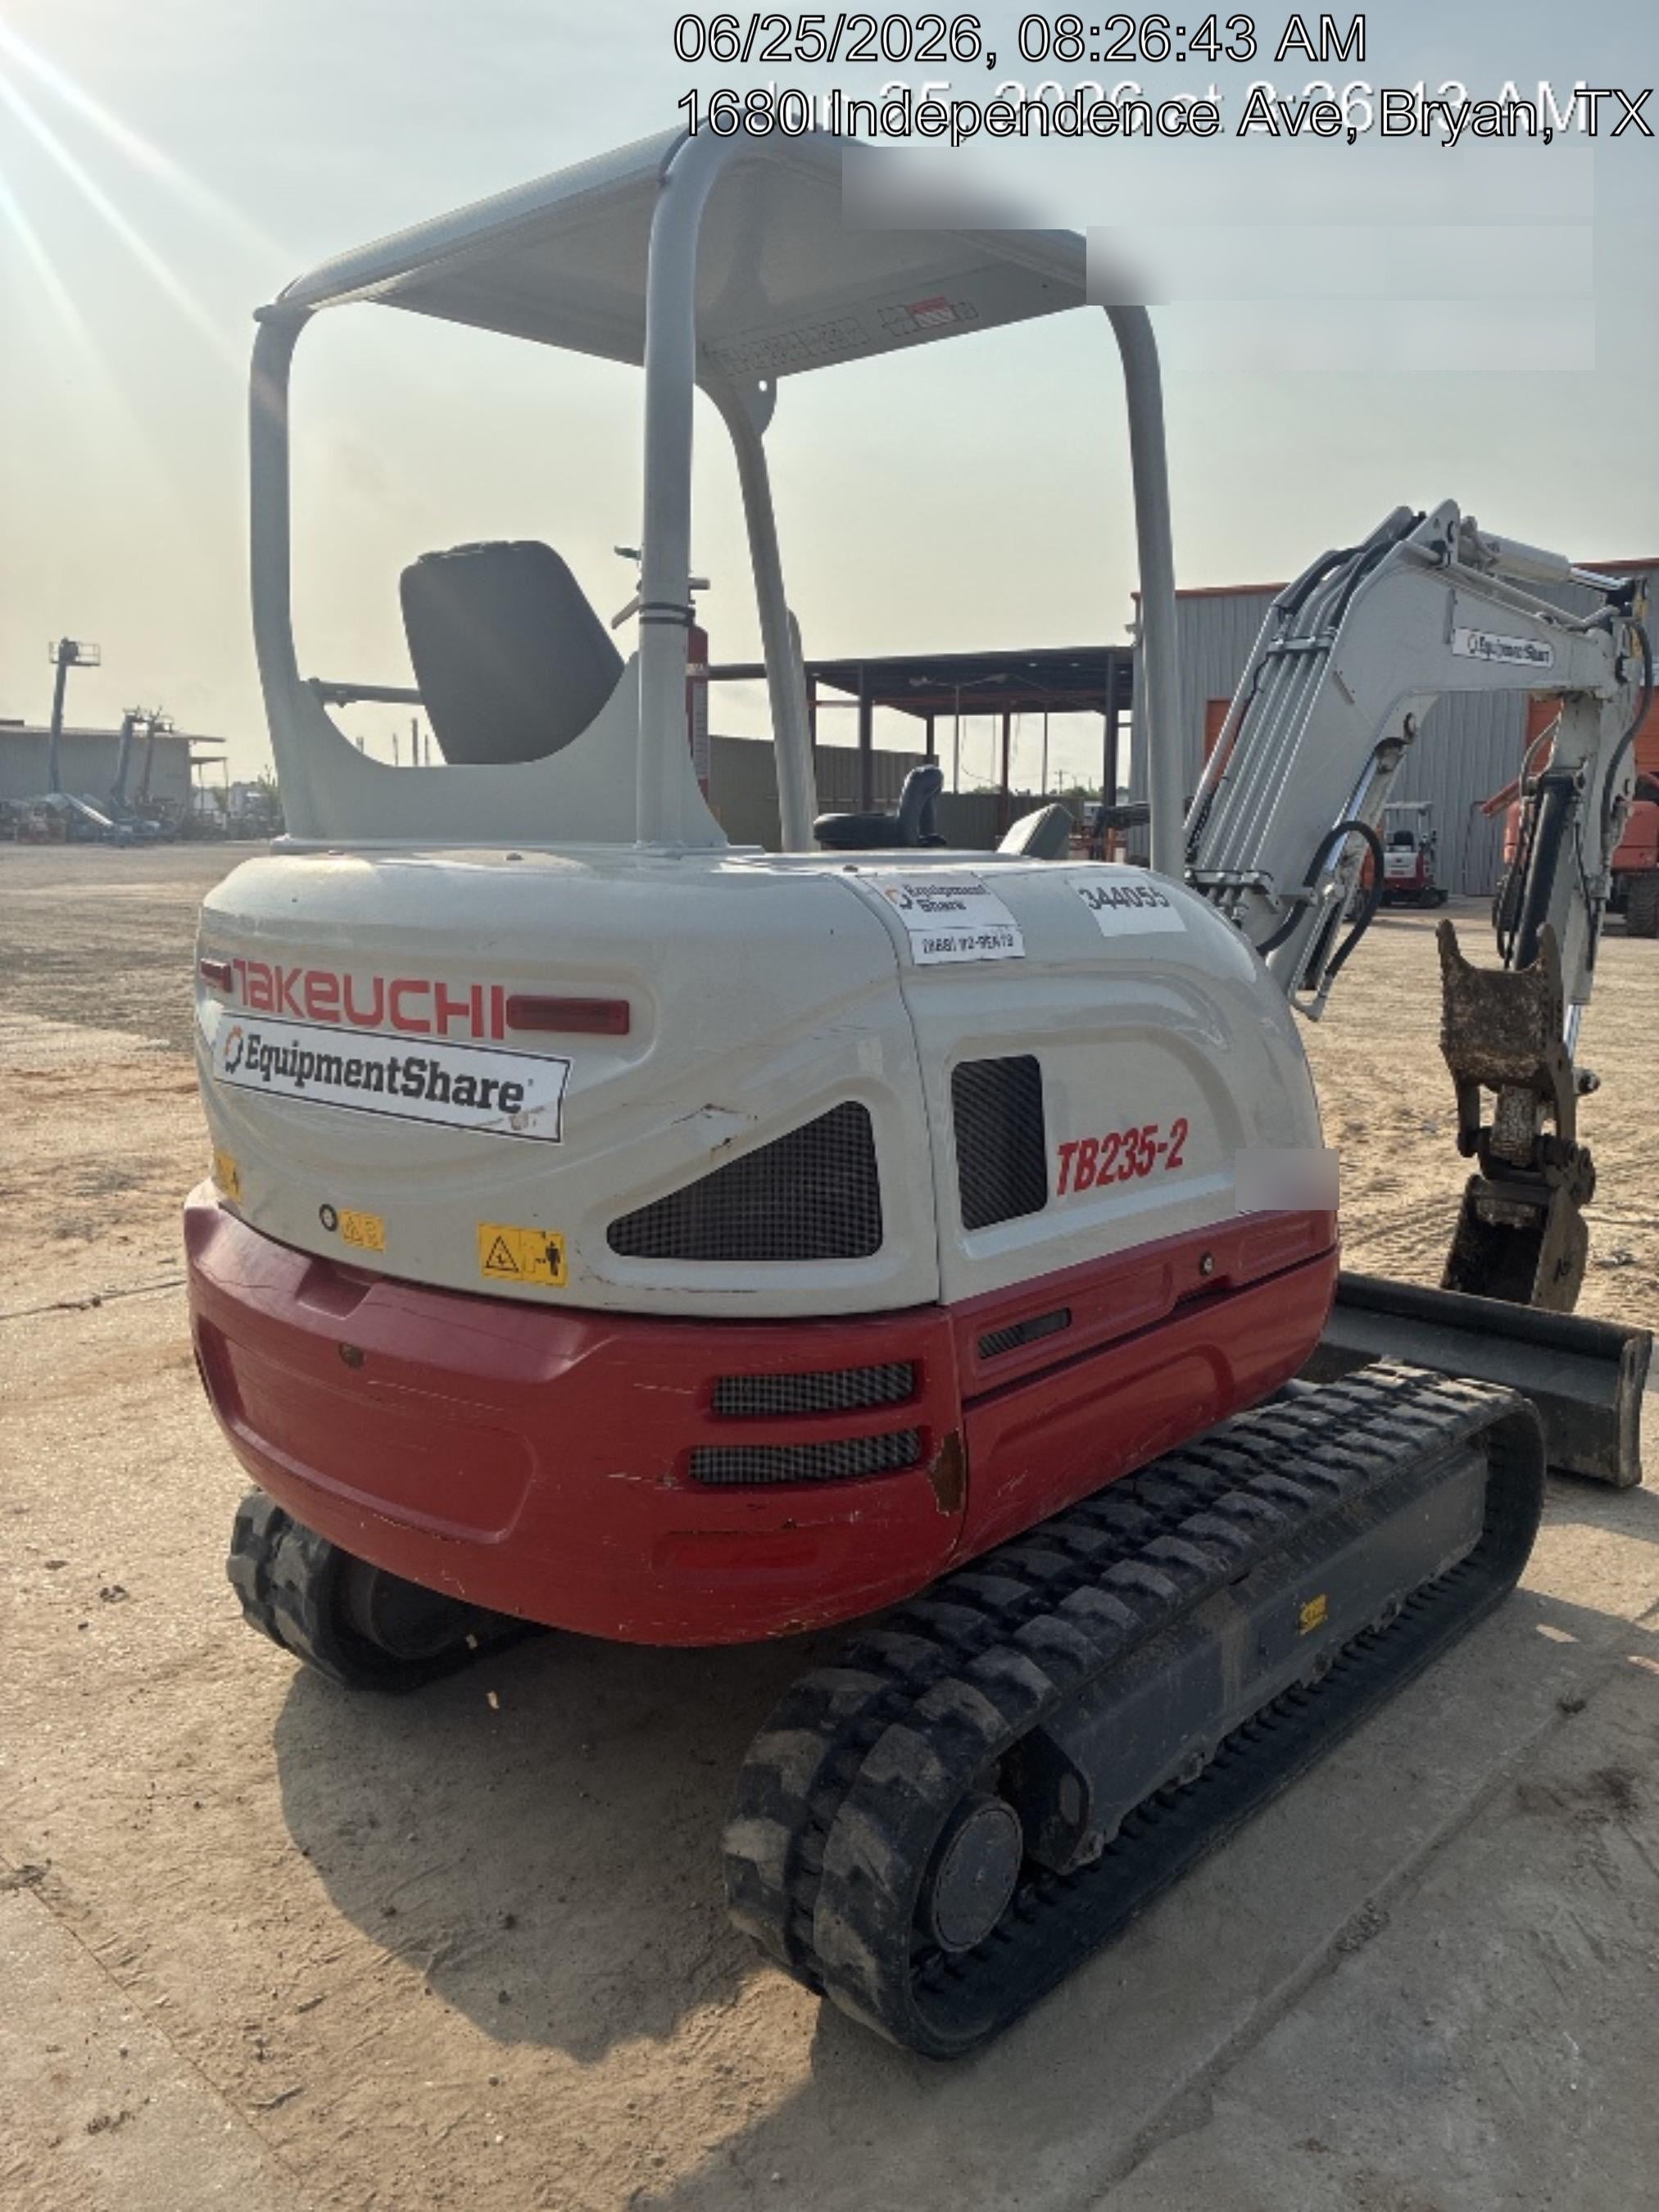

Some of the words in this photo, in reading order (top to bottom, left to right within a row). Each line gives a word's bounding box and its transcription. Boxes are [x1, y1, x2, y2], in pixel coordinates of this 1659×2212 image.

[1077, 886, 1171, 910] 344055
[233, 958, 505, 1040] TAKEUCHI
[246, 1034, 524, 1113] EquipmentShare
[1057, 1117, 1188, 1195] TB235-2
